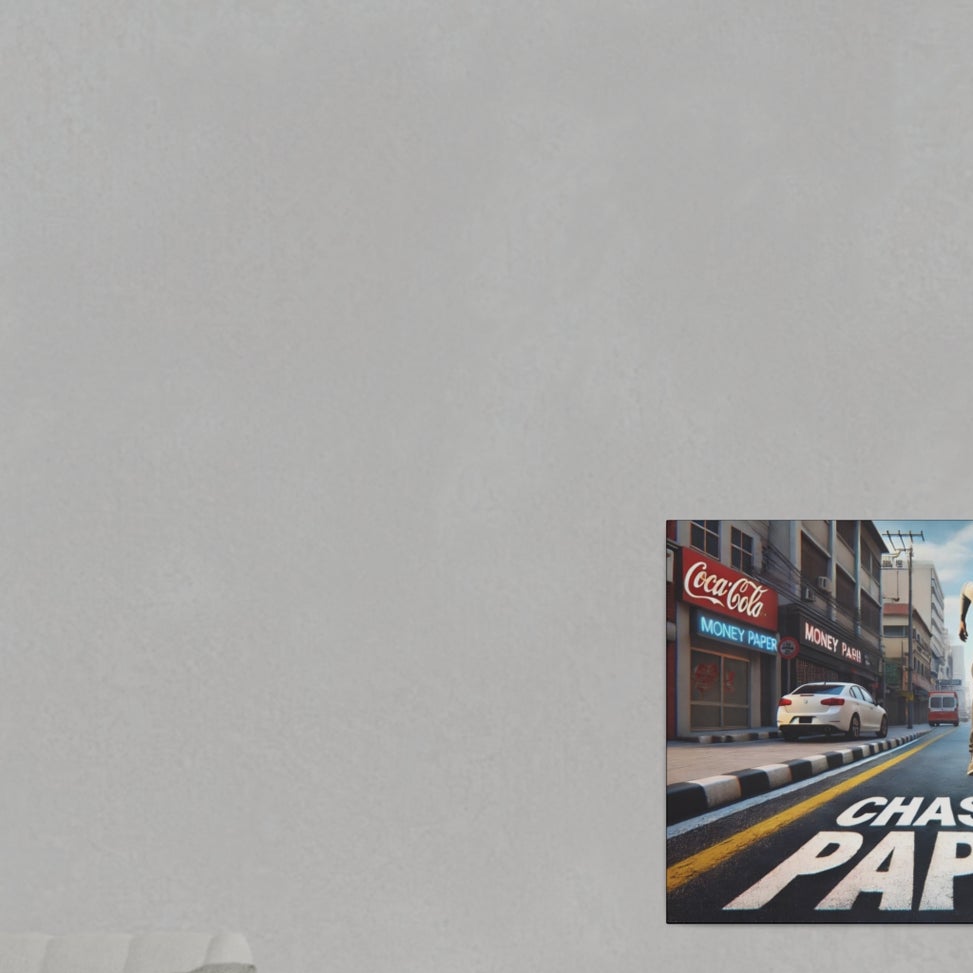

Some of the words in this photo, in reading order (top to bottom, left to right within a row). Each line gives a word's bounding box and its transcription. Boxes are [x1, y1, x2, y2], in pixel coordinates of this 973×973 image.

[701, 617, 745, 642] MONEY
[748, 629, 777, 651] PAPER
[805, 622, 838, 651] MONEY
